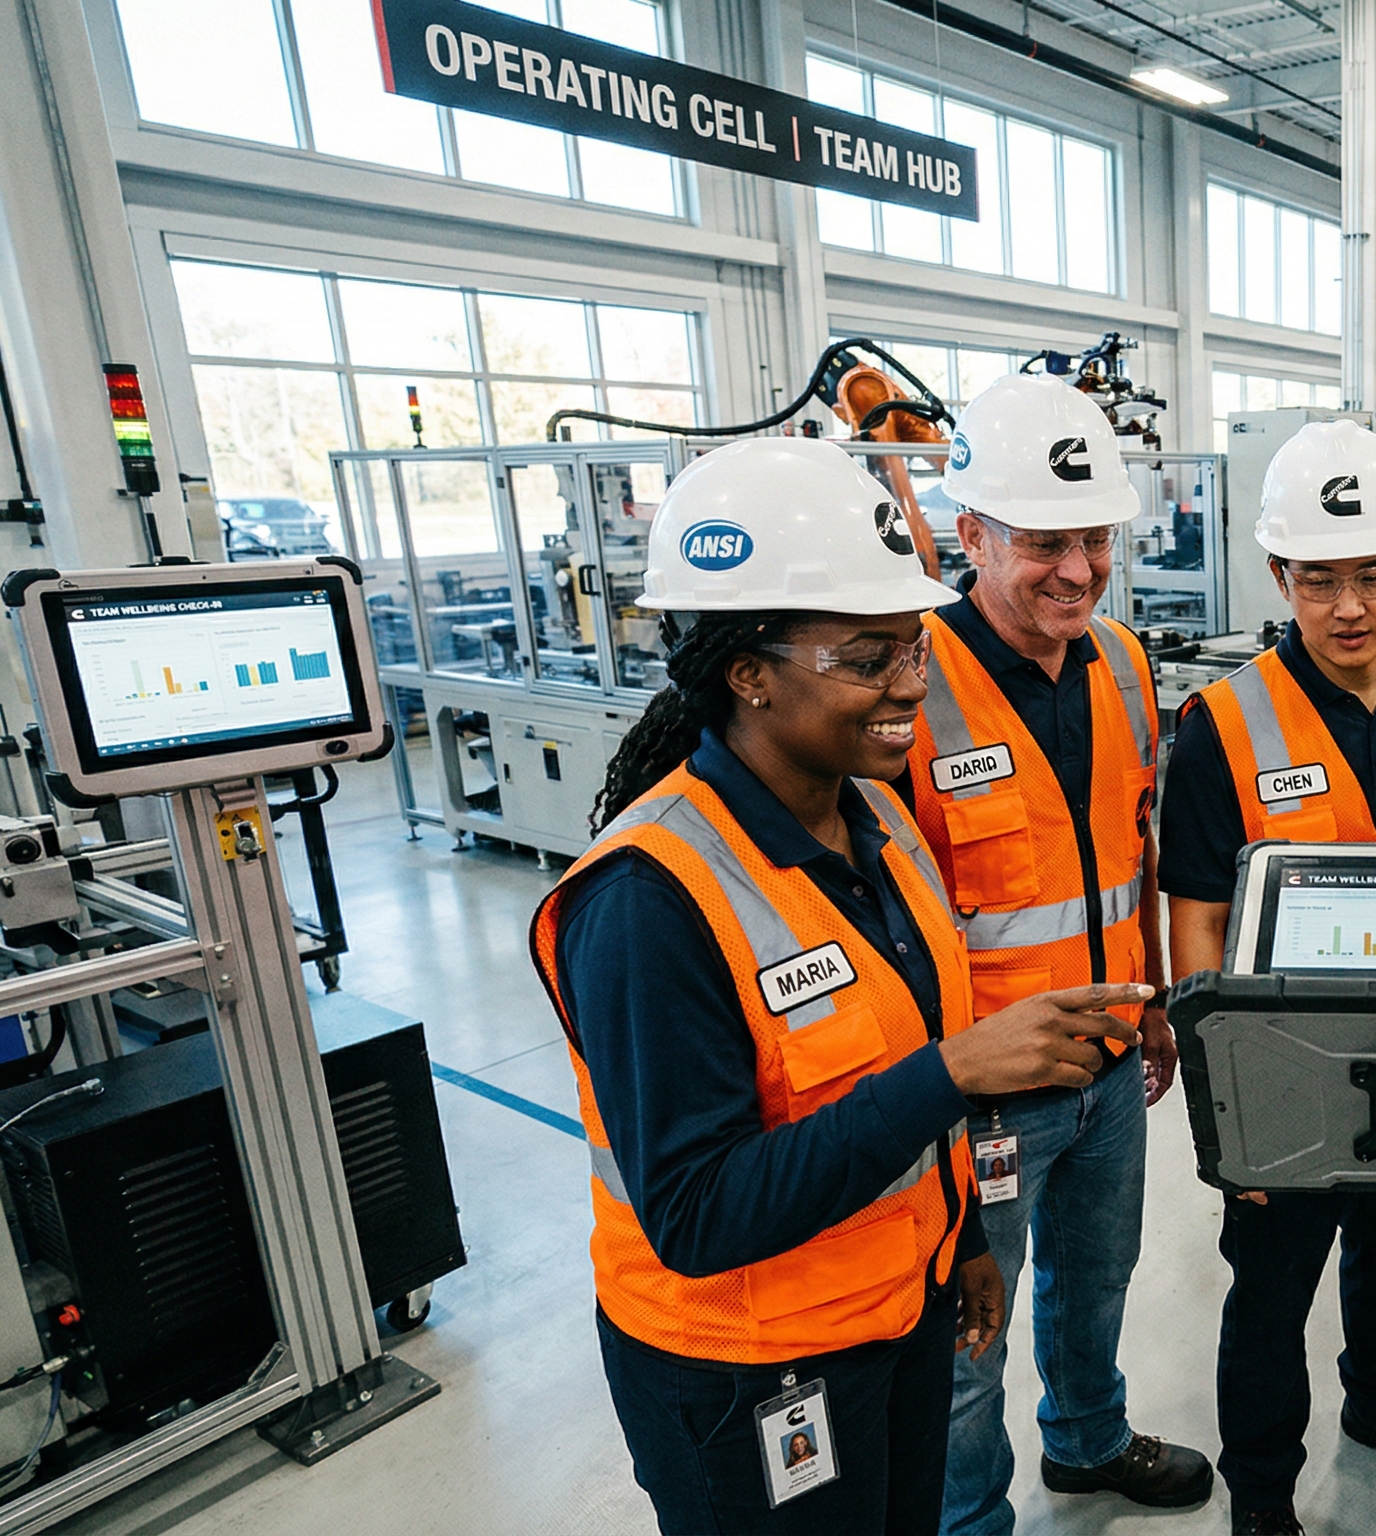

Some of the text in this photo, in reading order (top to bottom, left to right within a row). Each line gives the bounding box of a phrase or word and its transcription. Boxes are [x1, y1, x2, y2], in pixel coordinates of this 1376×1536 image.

[424, 24, 962, 197] OPERATING CELL TEAM HUB
[688, 534, 744, 559] ANSI
[90, 606, 120, 617] TEAM
[1272, 773, 1313, 793] CHEN
[1308, 875, 1337, 884] TEAM
[776, 956, 841, 997] MARIA
